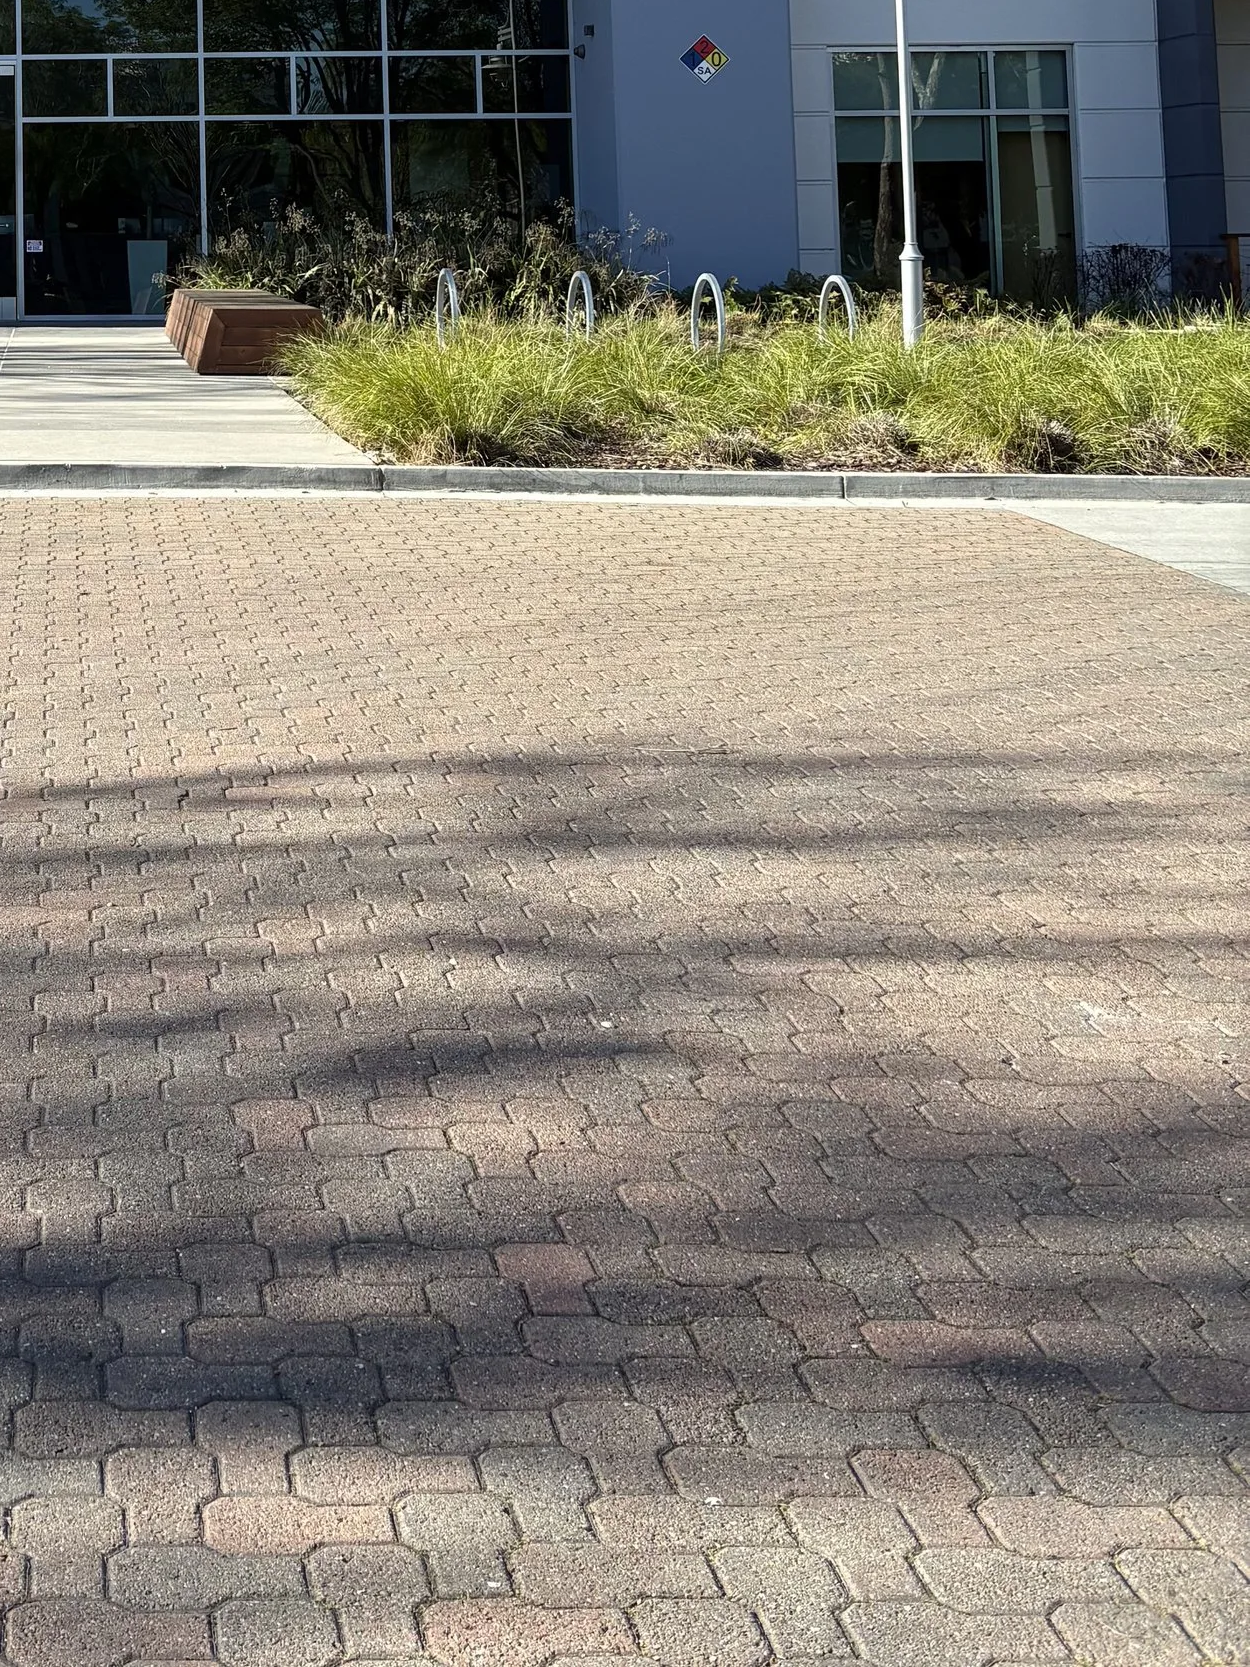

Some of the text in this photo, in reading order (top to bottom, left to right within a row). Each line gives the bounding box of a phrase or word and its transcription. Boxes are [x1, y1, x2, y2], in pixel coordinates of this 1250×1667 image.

[700, 40, 709, 54] 2
[712, 52, 722, 67] 0
[698, 66, 712, 75] SA
